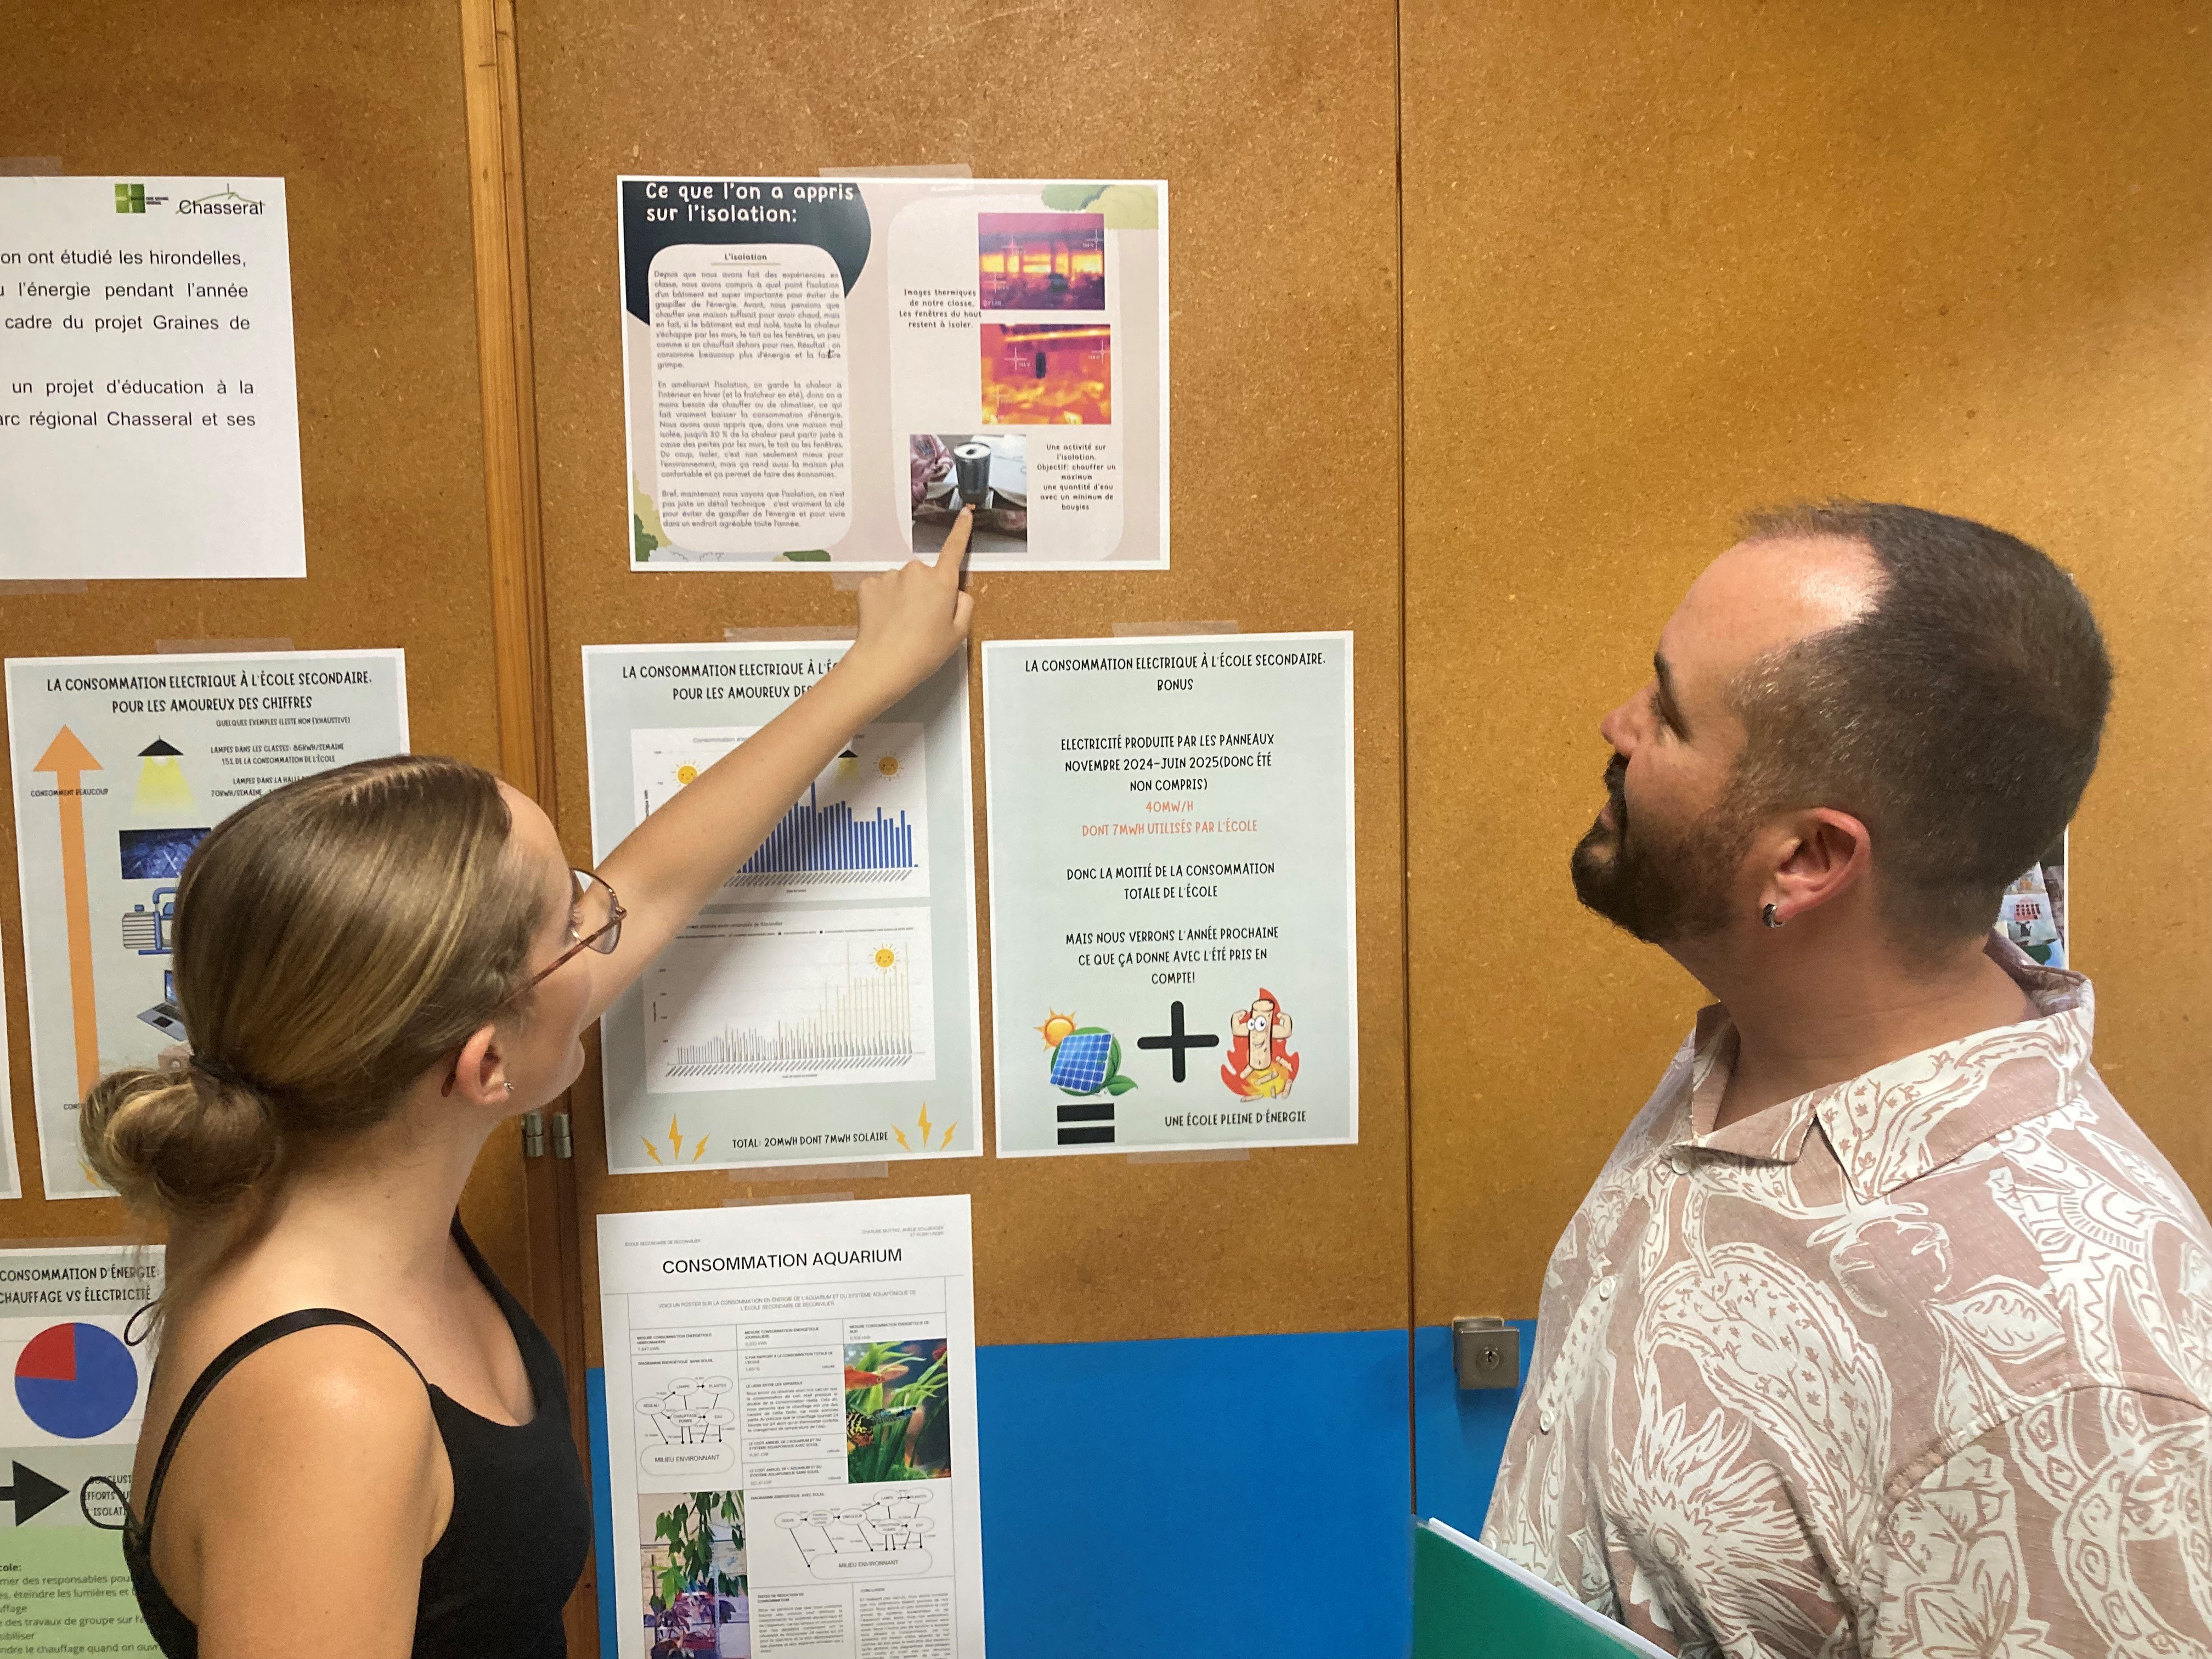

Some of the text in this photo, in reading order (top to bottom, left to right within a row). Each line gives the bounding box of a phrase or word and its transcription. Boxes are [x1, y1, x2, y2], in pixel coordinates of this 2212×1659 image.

[646, 182, 854, 203] Ce que l'on a appris
[178, 199, 263, 215] Chasseral
[647, 205, 797, 223] sur l'isolation:
[28, 250, 54, 264] ont
[61, 249, 112, 264] étudié
[119, 250, 143, 264] les
[150, 250, 246, 267] hirondelles,
[725, 252, 767, 261] L'isolation
[19, 281, 248, 301] l'énergie pendant l'année
[904, 288, 976, 298] Images thermiques
[899, 309, 911, 318] Les
[915, 309, 947, 318] fenêtres
[951, 309, 961, 318] du
[5, 314, 250, 333] cadre du projet Graines de
[12, 379, 253, 398] un projet d'éducation à la
[29, 411, 255, 430] régional Chasseral et ses
[1063, 443, 1092, 451] activité
[1059, 483, 1091, 492] quantité
[1062, 503, 1089, 512] bougies
[623, 658, 815, 679] LA CONSOMMATION ELECTRIQUE À
[1025, 652, 1325, 673] LA CONSOMMATION ELECTRIQUE À L'ÉCOLE SECONDAIRE.
[47, 670, 372, 692] LA CONSOMMATION ELECTRIQUE À L'ÉCOLE SECONDAIRE.
[1157, 678, 1194, 691] BONUS
[673, 686, 790, 701] POUR LES AMOUREUX
[112, 696, 312, 714] POUR LES AMOUREUX DES CHIFFRES
[1061, 733, 1274, 751] ELECTRICITÉ PRODUITE PAR LES PANNEAUX
[1065, 759, 1120, 772] NOVEMBRE
[1257, 752, 1272, 767] ÉTÉ
[1130, 778, 1207, 792] NON COMPRIS)
[1146, 800, 1193, 813] 40MW/H
[1082, 818, 1257, 837] DONT 7MWH UTILISÉS PAR L'ÉCOLE
[1066, 862, 1274, 881] DONC LA MOITIÉ DE LA CONSOMMATION
[1124, 883, 1217, 900] TOTALE DE L'ÉCOLE
[1066, 926, 1278, 945] MAIS NOUS VERRONS L'ANNÉE PROCHAINE
[1079, 947, 1267, 967] CE QUE ÇA DONNE AVEC L'ÉTÉ PRIS EN
[1152, 971, 1195, 985] COMPTE!
[1165, 1109, 1306, 1127] UNE ÉCOLE PLEINE D'ÉNERGIE
[764, 1136, 798, 1148] 20MWH
[800, 1135, 822, 1146] DONT
[825, 1133, 850, 1144] 7MWH
[853, 1131, 888, 1142] SOLAIRE
[663, 1248, 901, 1274] CONSOMMATION AQUARIUM
[0, 1267, 97, 1282] CONSOMMATION
[66, 1290, 81, 1302] VS
[84, 1285, 151, 1302] ÉLECTRICITÉ
